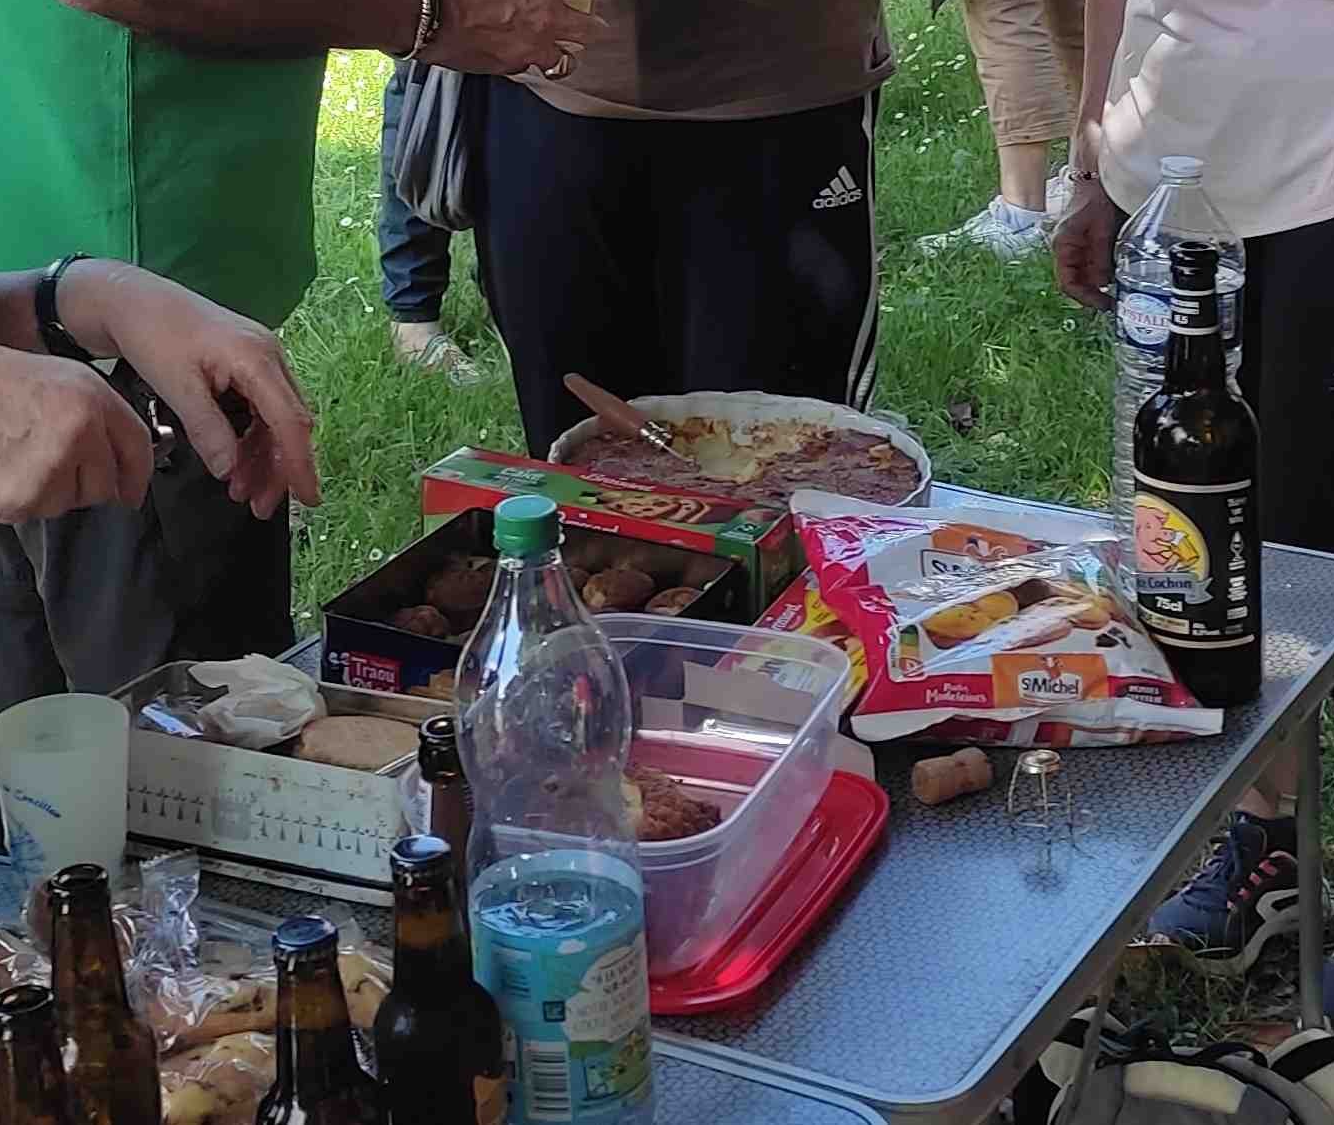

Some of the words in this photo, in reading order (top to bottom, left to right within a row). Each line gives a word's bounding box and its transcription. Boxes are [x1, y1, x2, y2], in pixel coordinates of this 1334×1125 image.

[812, 188, 862, 209] adidas
[1148, 576, 1192, 589] Cochon
[1155, 596, 1183, 612] 75cl
[351, 656, 395, 683] Traou
